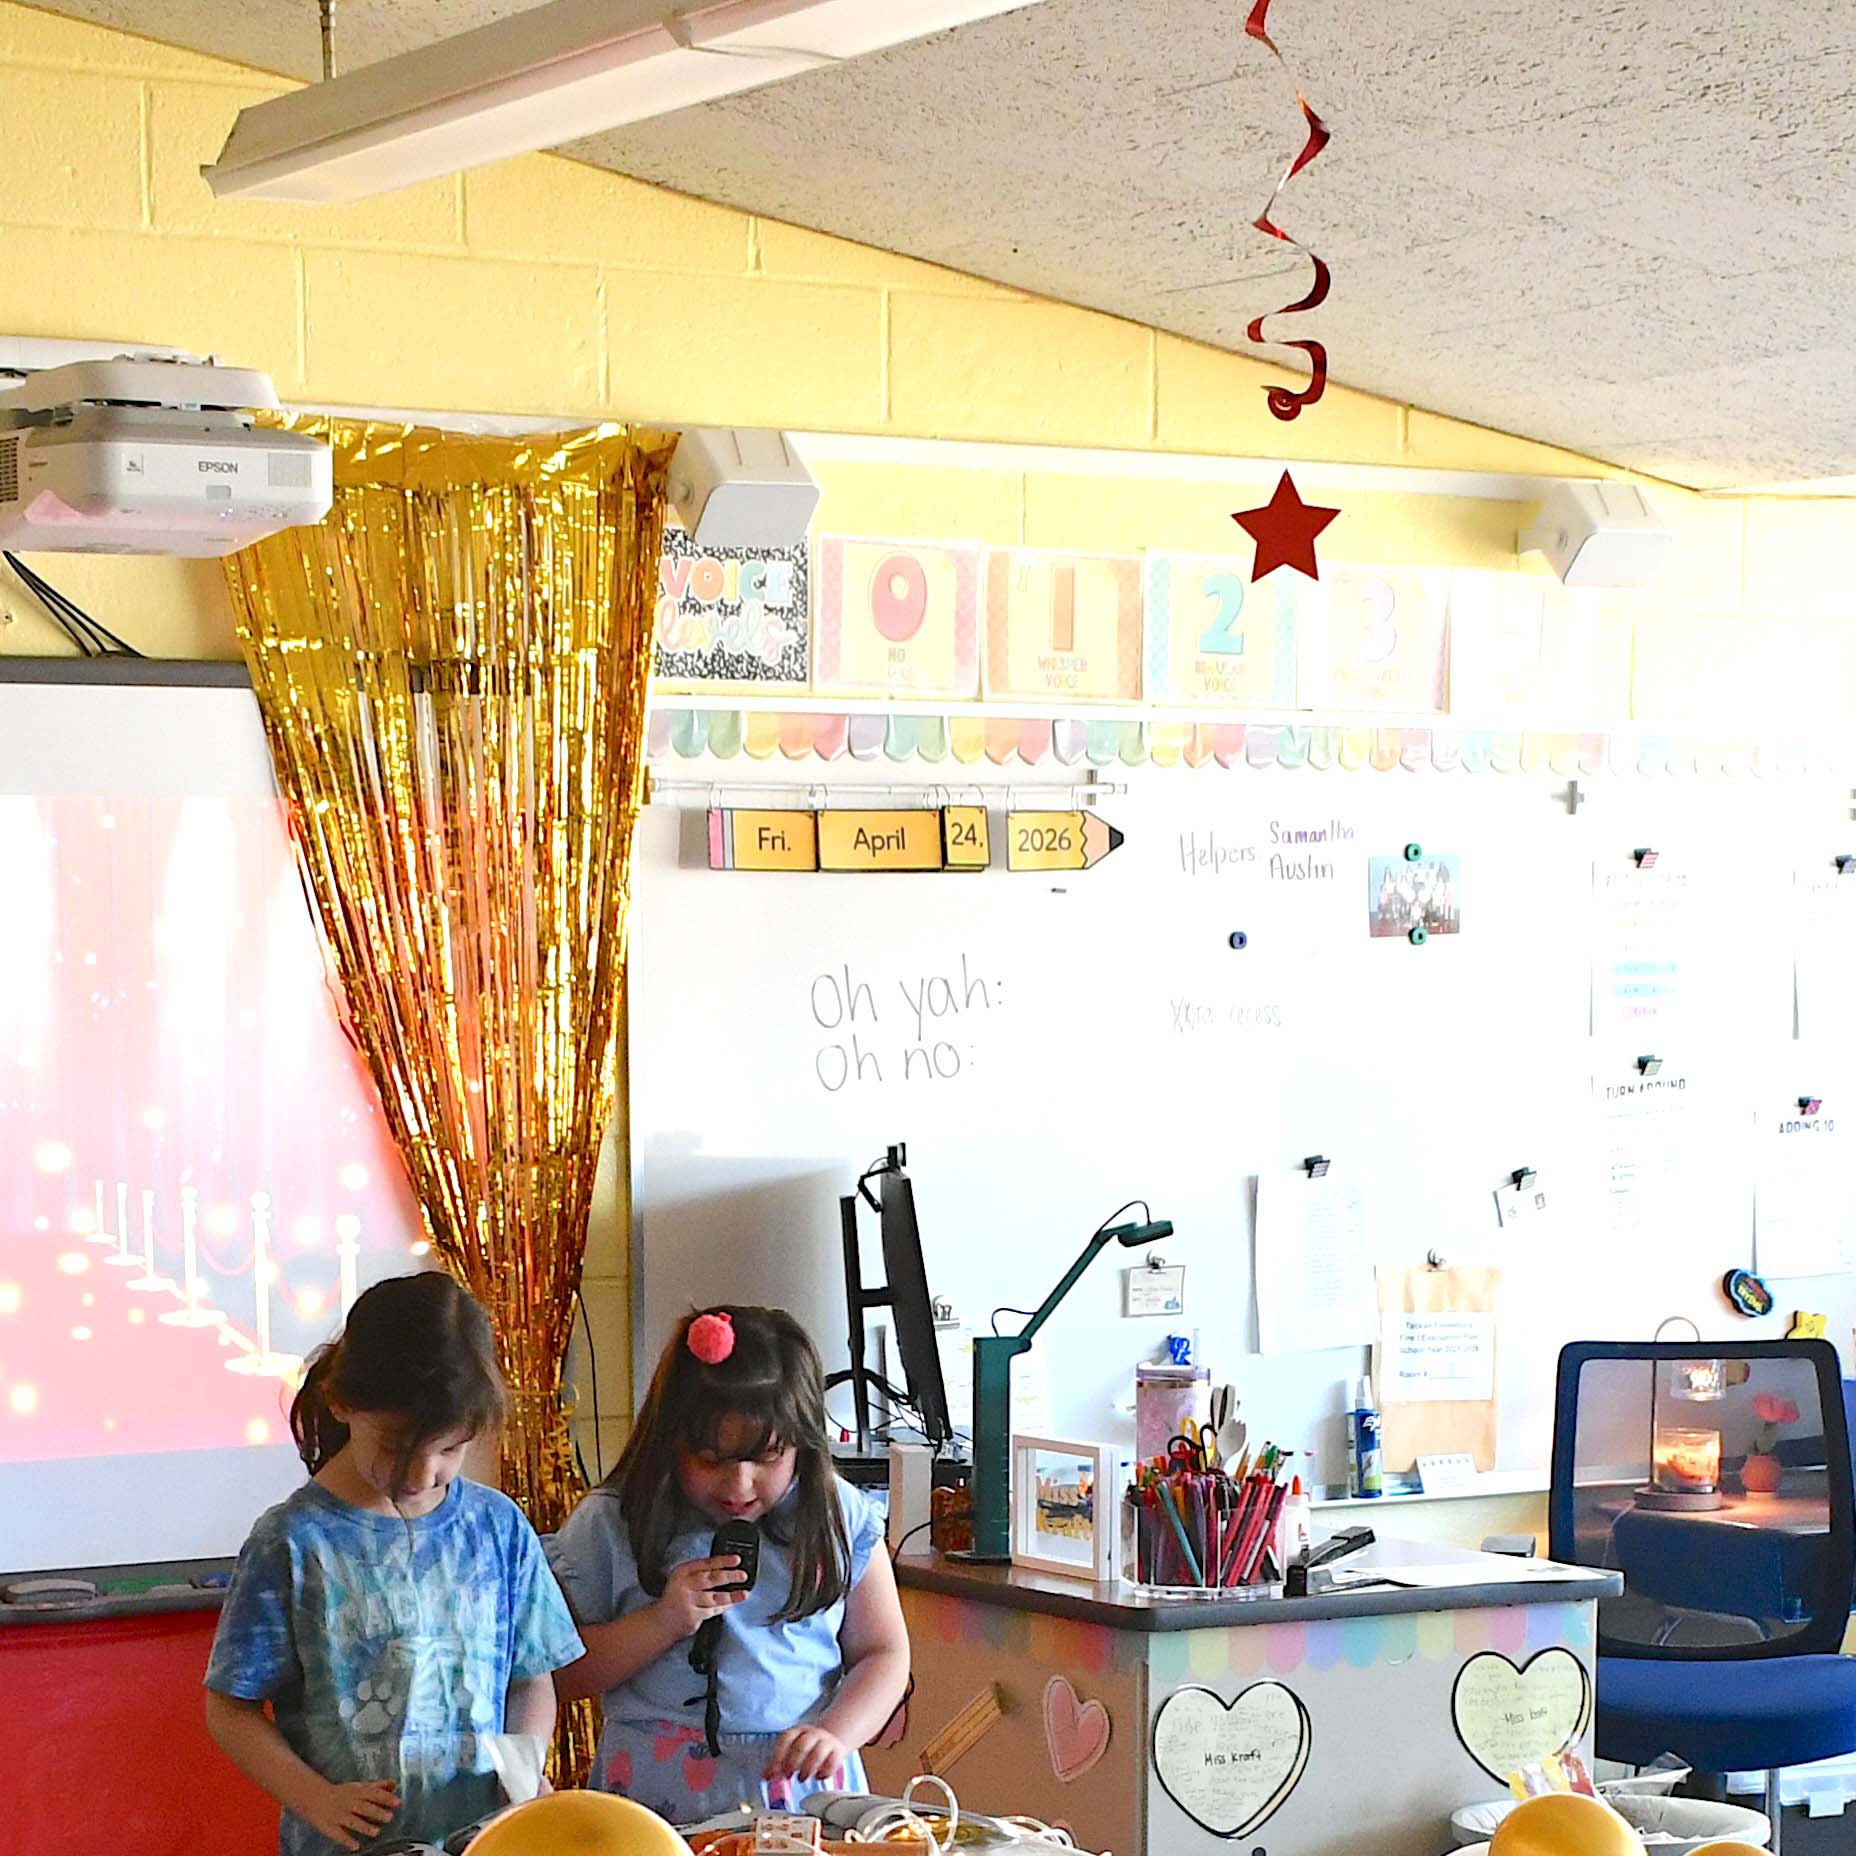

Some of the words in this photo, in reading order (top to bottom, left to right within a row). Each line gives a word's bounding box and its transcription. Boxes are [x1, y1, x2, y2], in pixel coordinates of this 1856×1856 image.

[198, 461, 238, 474] EPSON
[660, 559, 793, 603] VOICE
[1200, 571, 1245, 656] 2
[757, 826, 792, 852] Fri.
[853, 826, 906, 858] April
[1018, 827, 1072, 852] 2026
